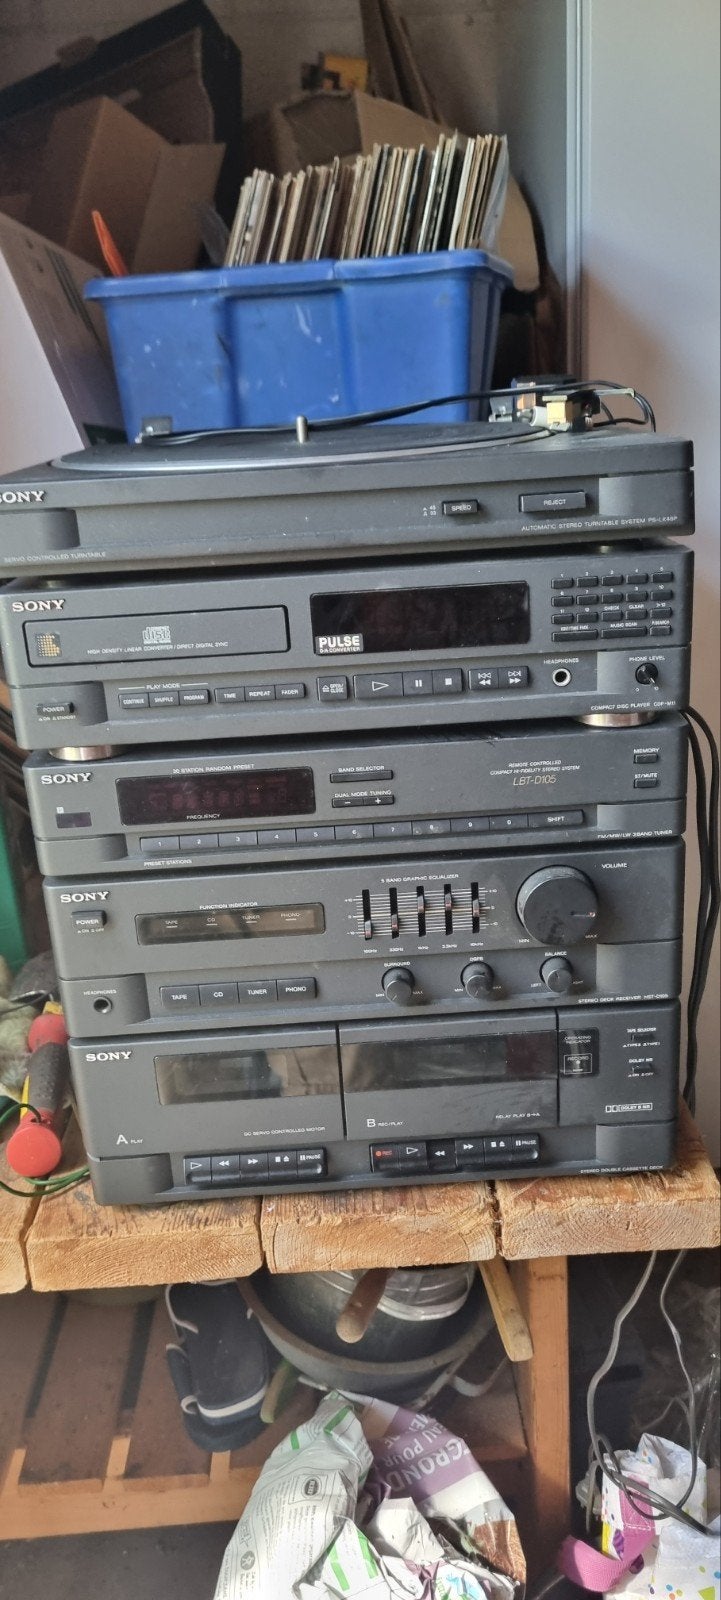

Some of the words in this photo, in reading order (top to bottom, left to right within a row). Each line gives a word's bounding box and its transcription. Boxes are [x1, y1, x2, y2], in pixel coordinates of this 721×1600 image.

[0, 490, 45, 504] ONY
[543, 498, 566, 506] REJECT
[521, 523, 556, 532] AUTOMATIC
[584, 519, 619, 527] TURNTABLE
[620, 517, 646, 525] SYSTEM
[4, 556, 25, 564] SERVO
[26, 553, 69, 561] CONTROLLED
[70, 551, 106, 559] TURNTABLE
[12, 600, 65, 612] SONY
[318, 635, 360, 649] PULSE
[41, 773, 92, 785] SONY
[512, 774, 556, 786] LBT-D105
[60, 892, 109, 903] SONY
[228, 901, 258, 909] INDICATOR
[86, 1051, 132, 1062] SONY
[366, 1118, 376, 1128] B
[116, 1134, 129, 1145] A
[385, 1438, 425, 1468] POUR
